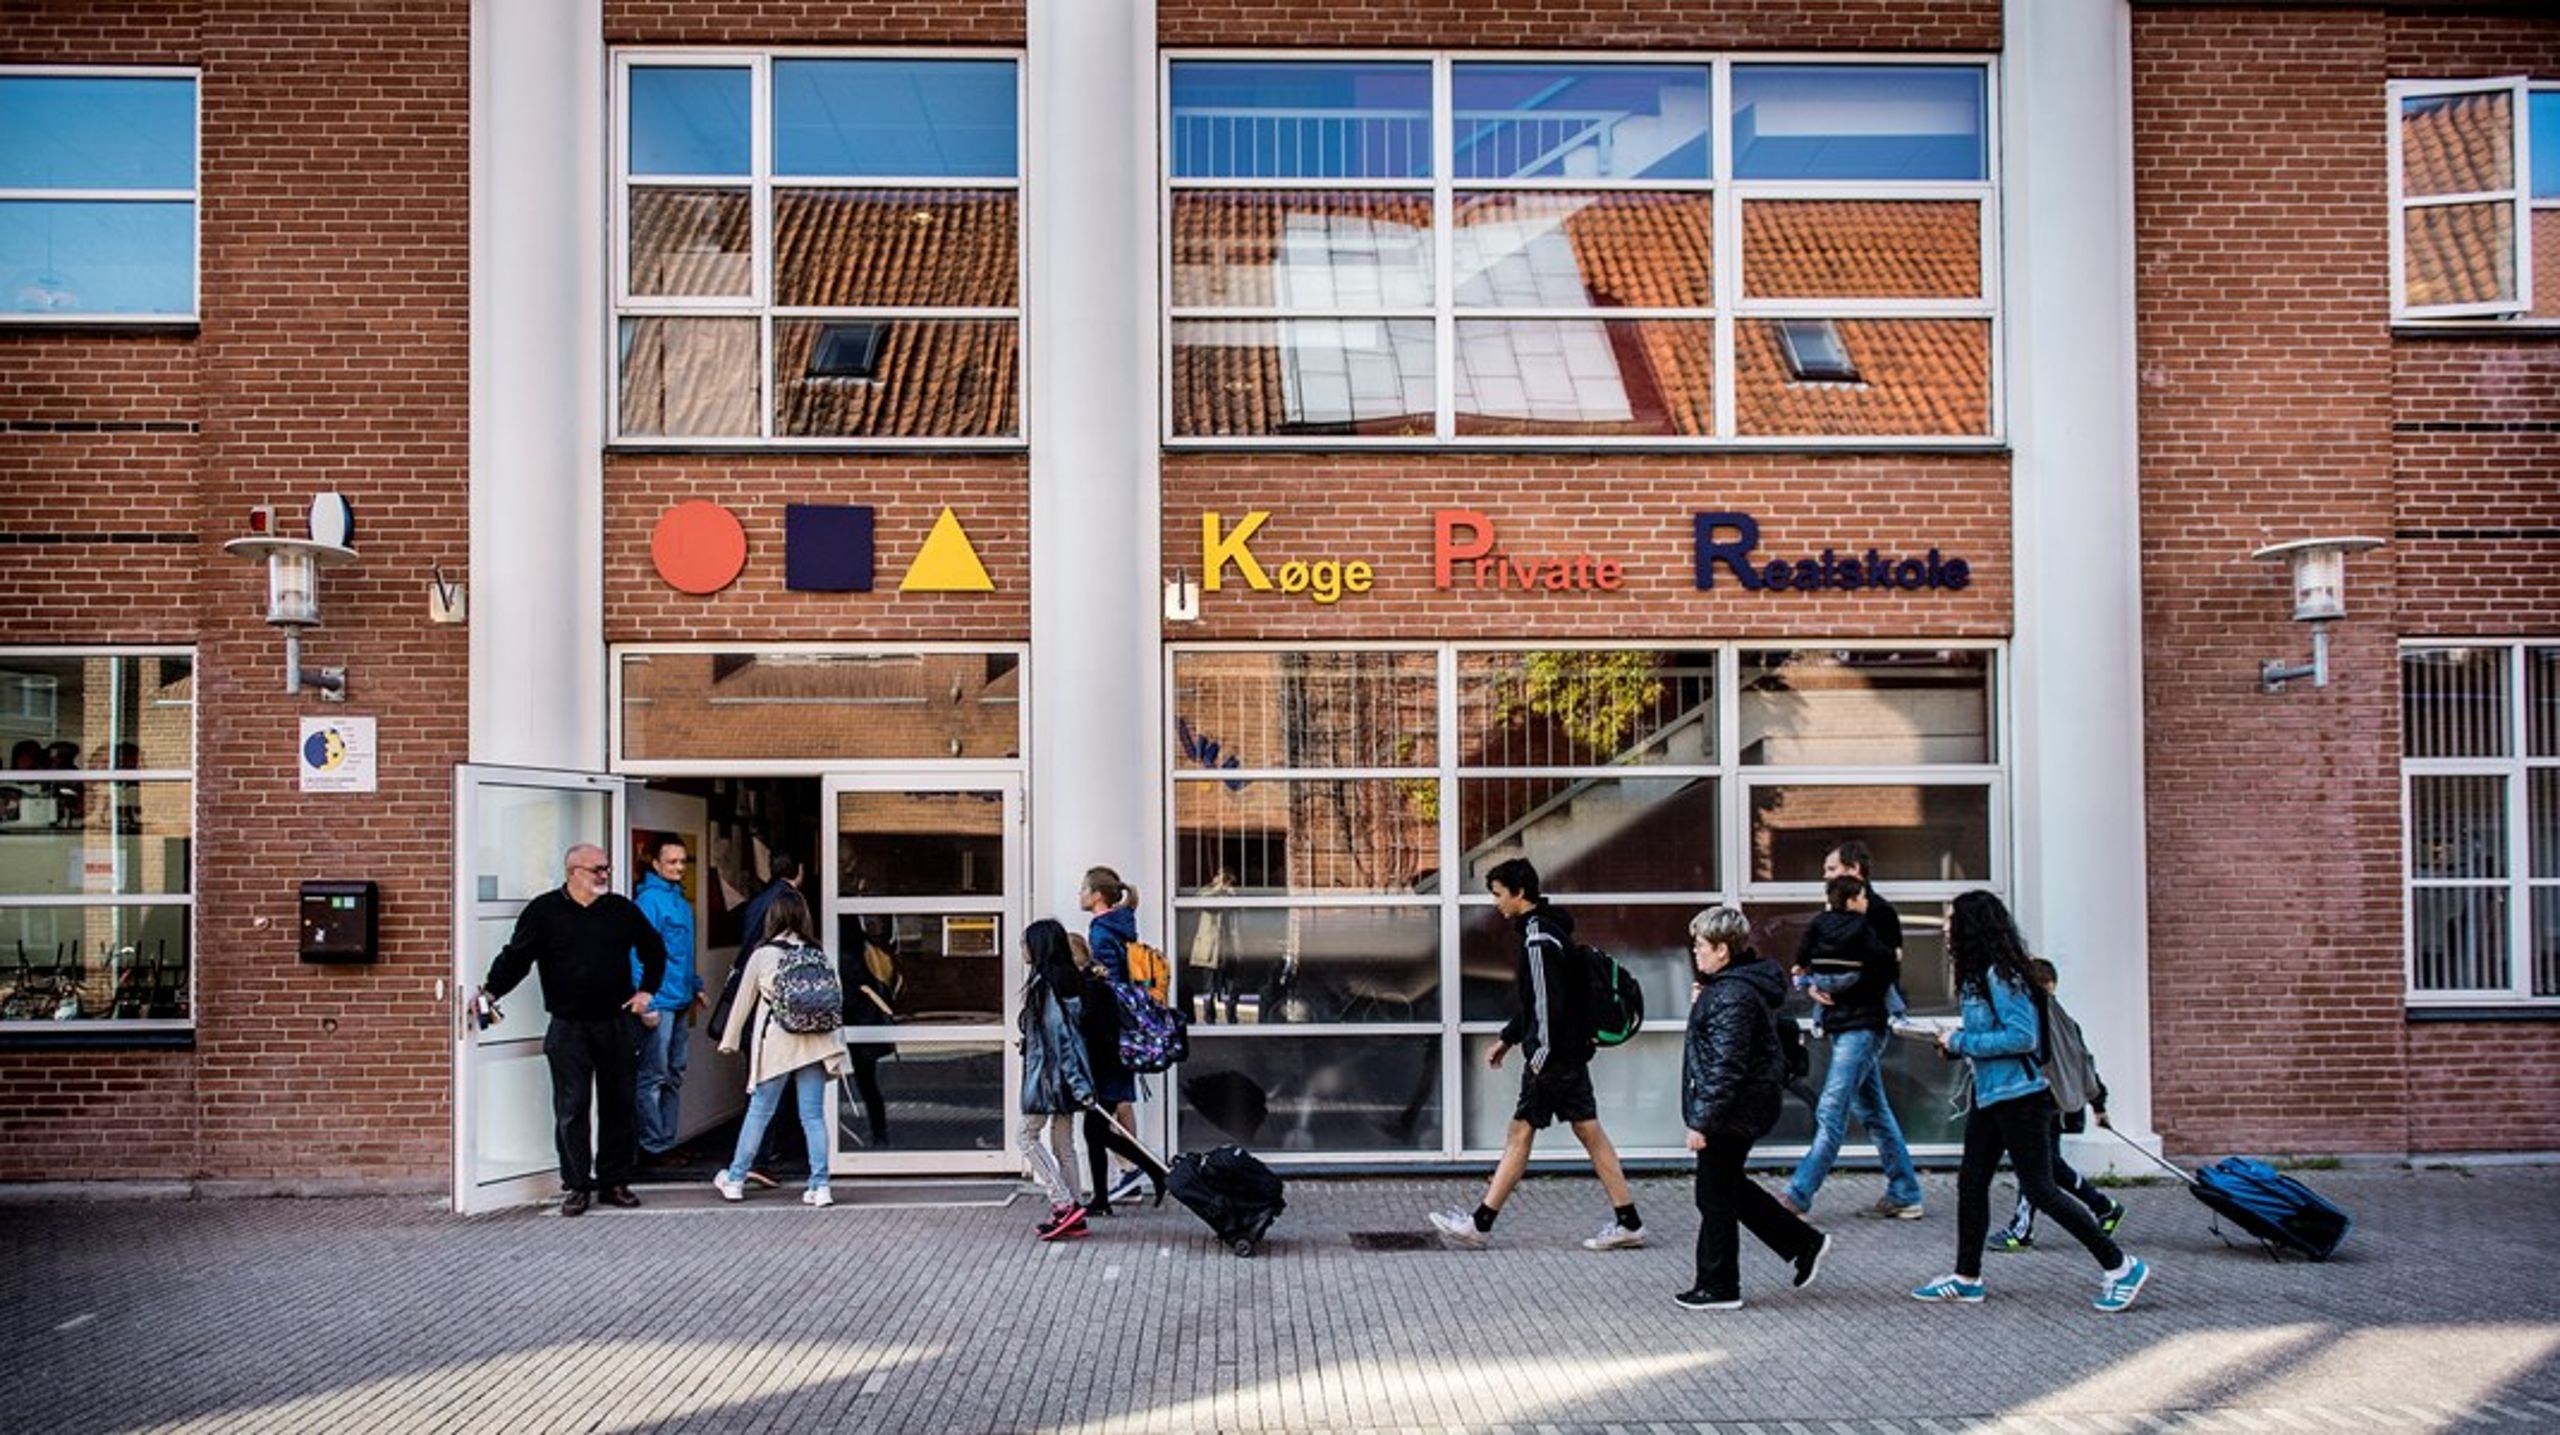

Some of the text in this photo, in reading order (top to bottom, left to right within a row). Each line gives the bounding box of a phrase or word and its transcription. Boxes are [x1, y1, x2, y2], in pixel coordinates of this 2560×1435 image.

[1202, 510, 1971, 603] Køge Private Realskole
